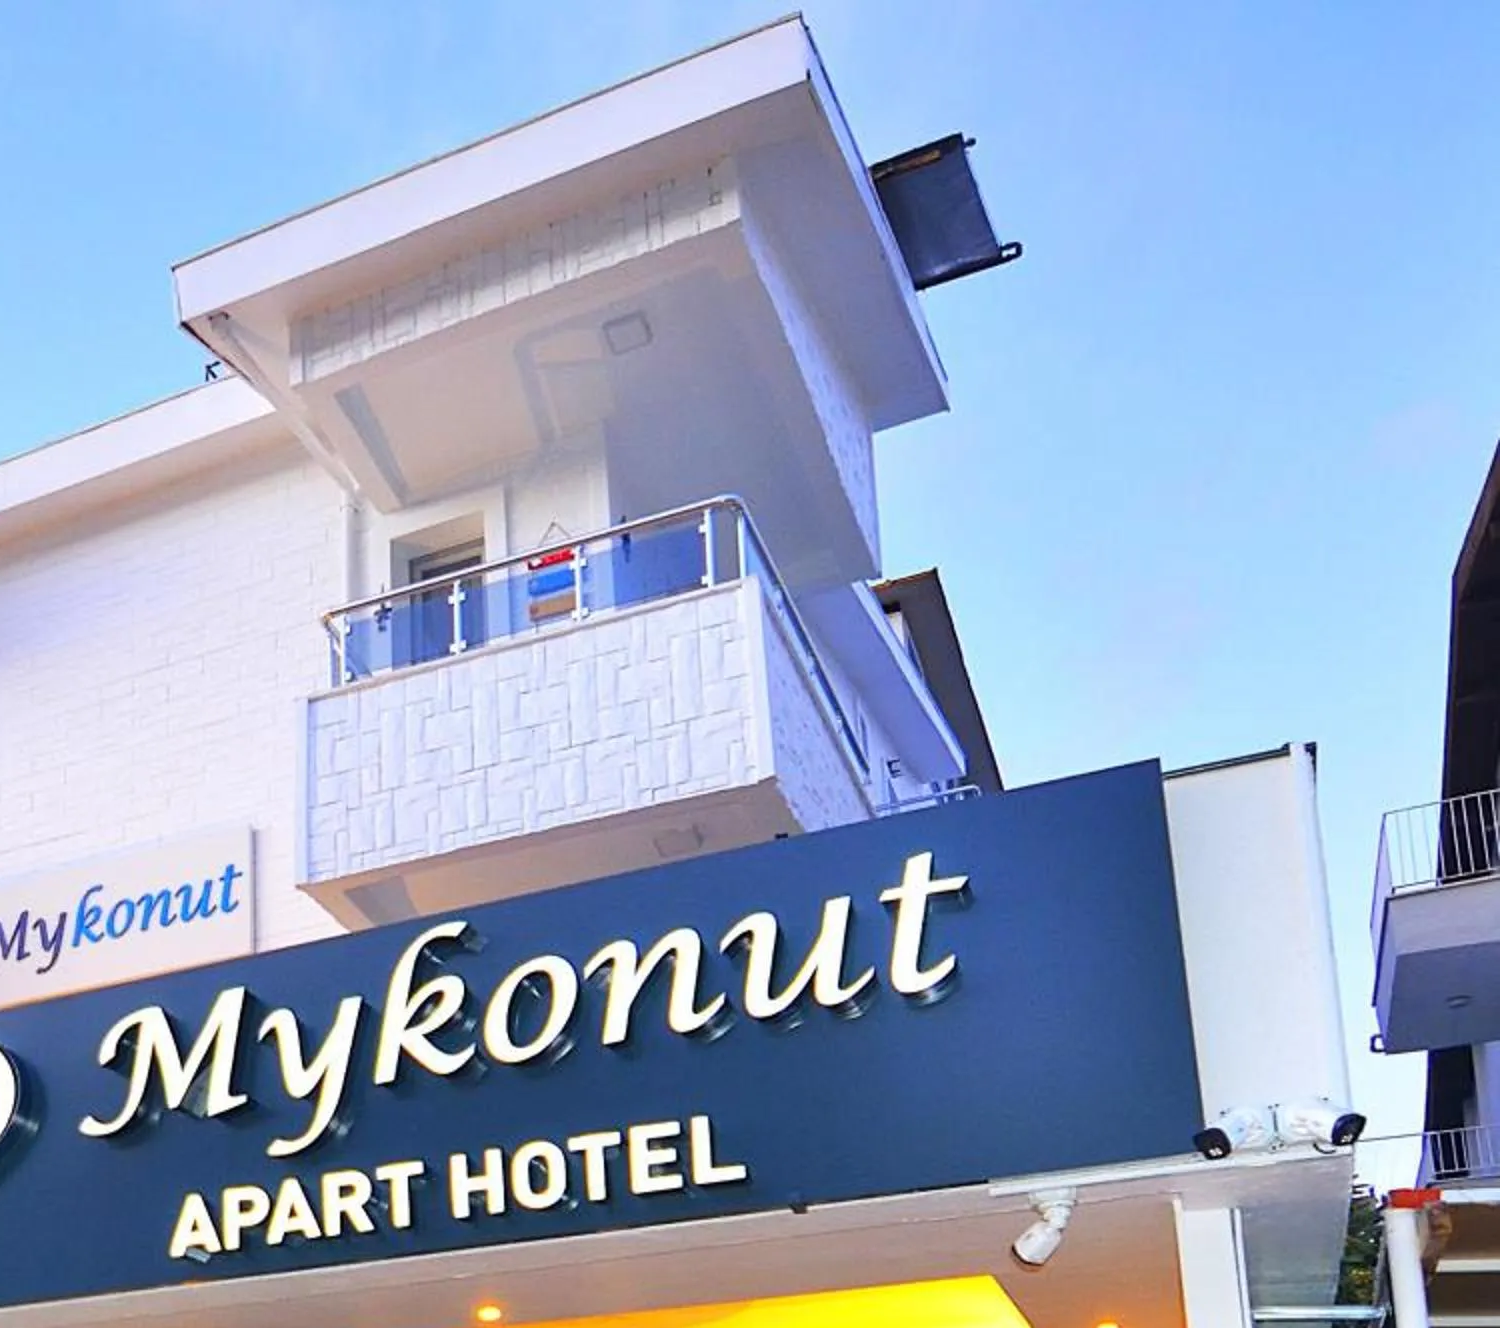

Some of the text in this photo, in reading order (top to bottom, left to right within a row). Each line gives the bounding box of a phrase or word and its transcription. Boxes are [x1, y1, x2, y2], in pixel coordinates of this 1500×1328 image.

[79, 851, 971, 1157] Mykonut
[169, 1114, 748, 1258] APART HOTEL
